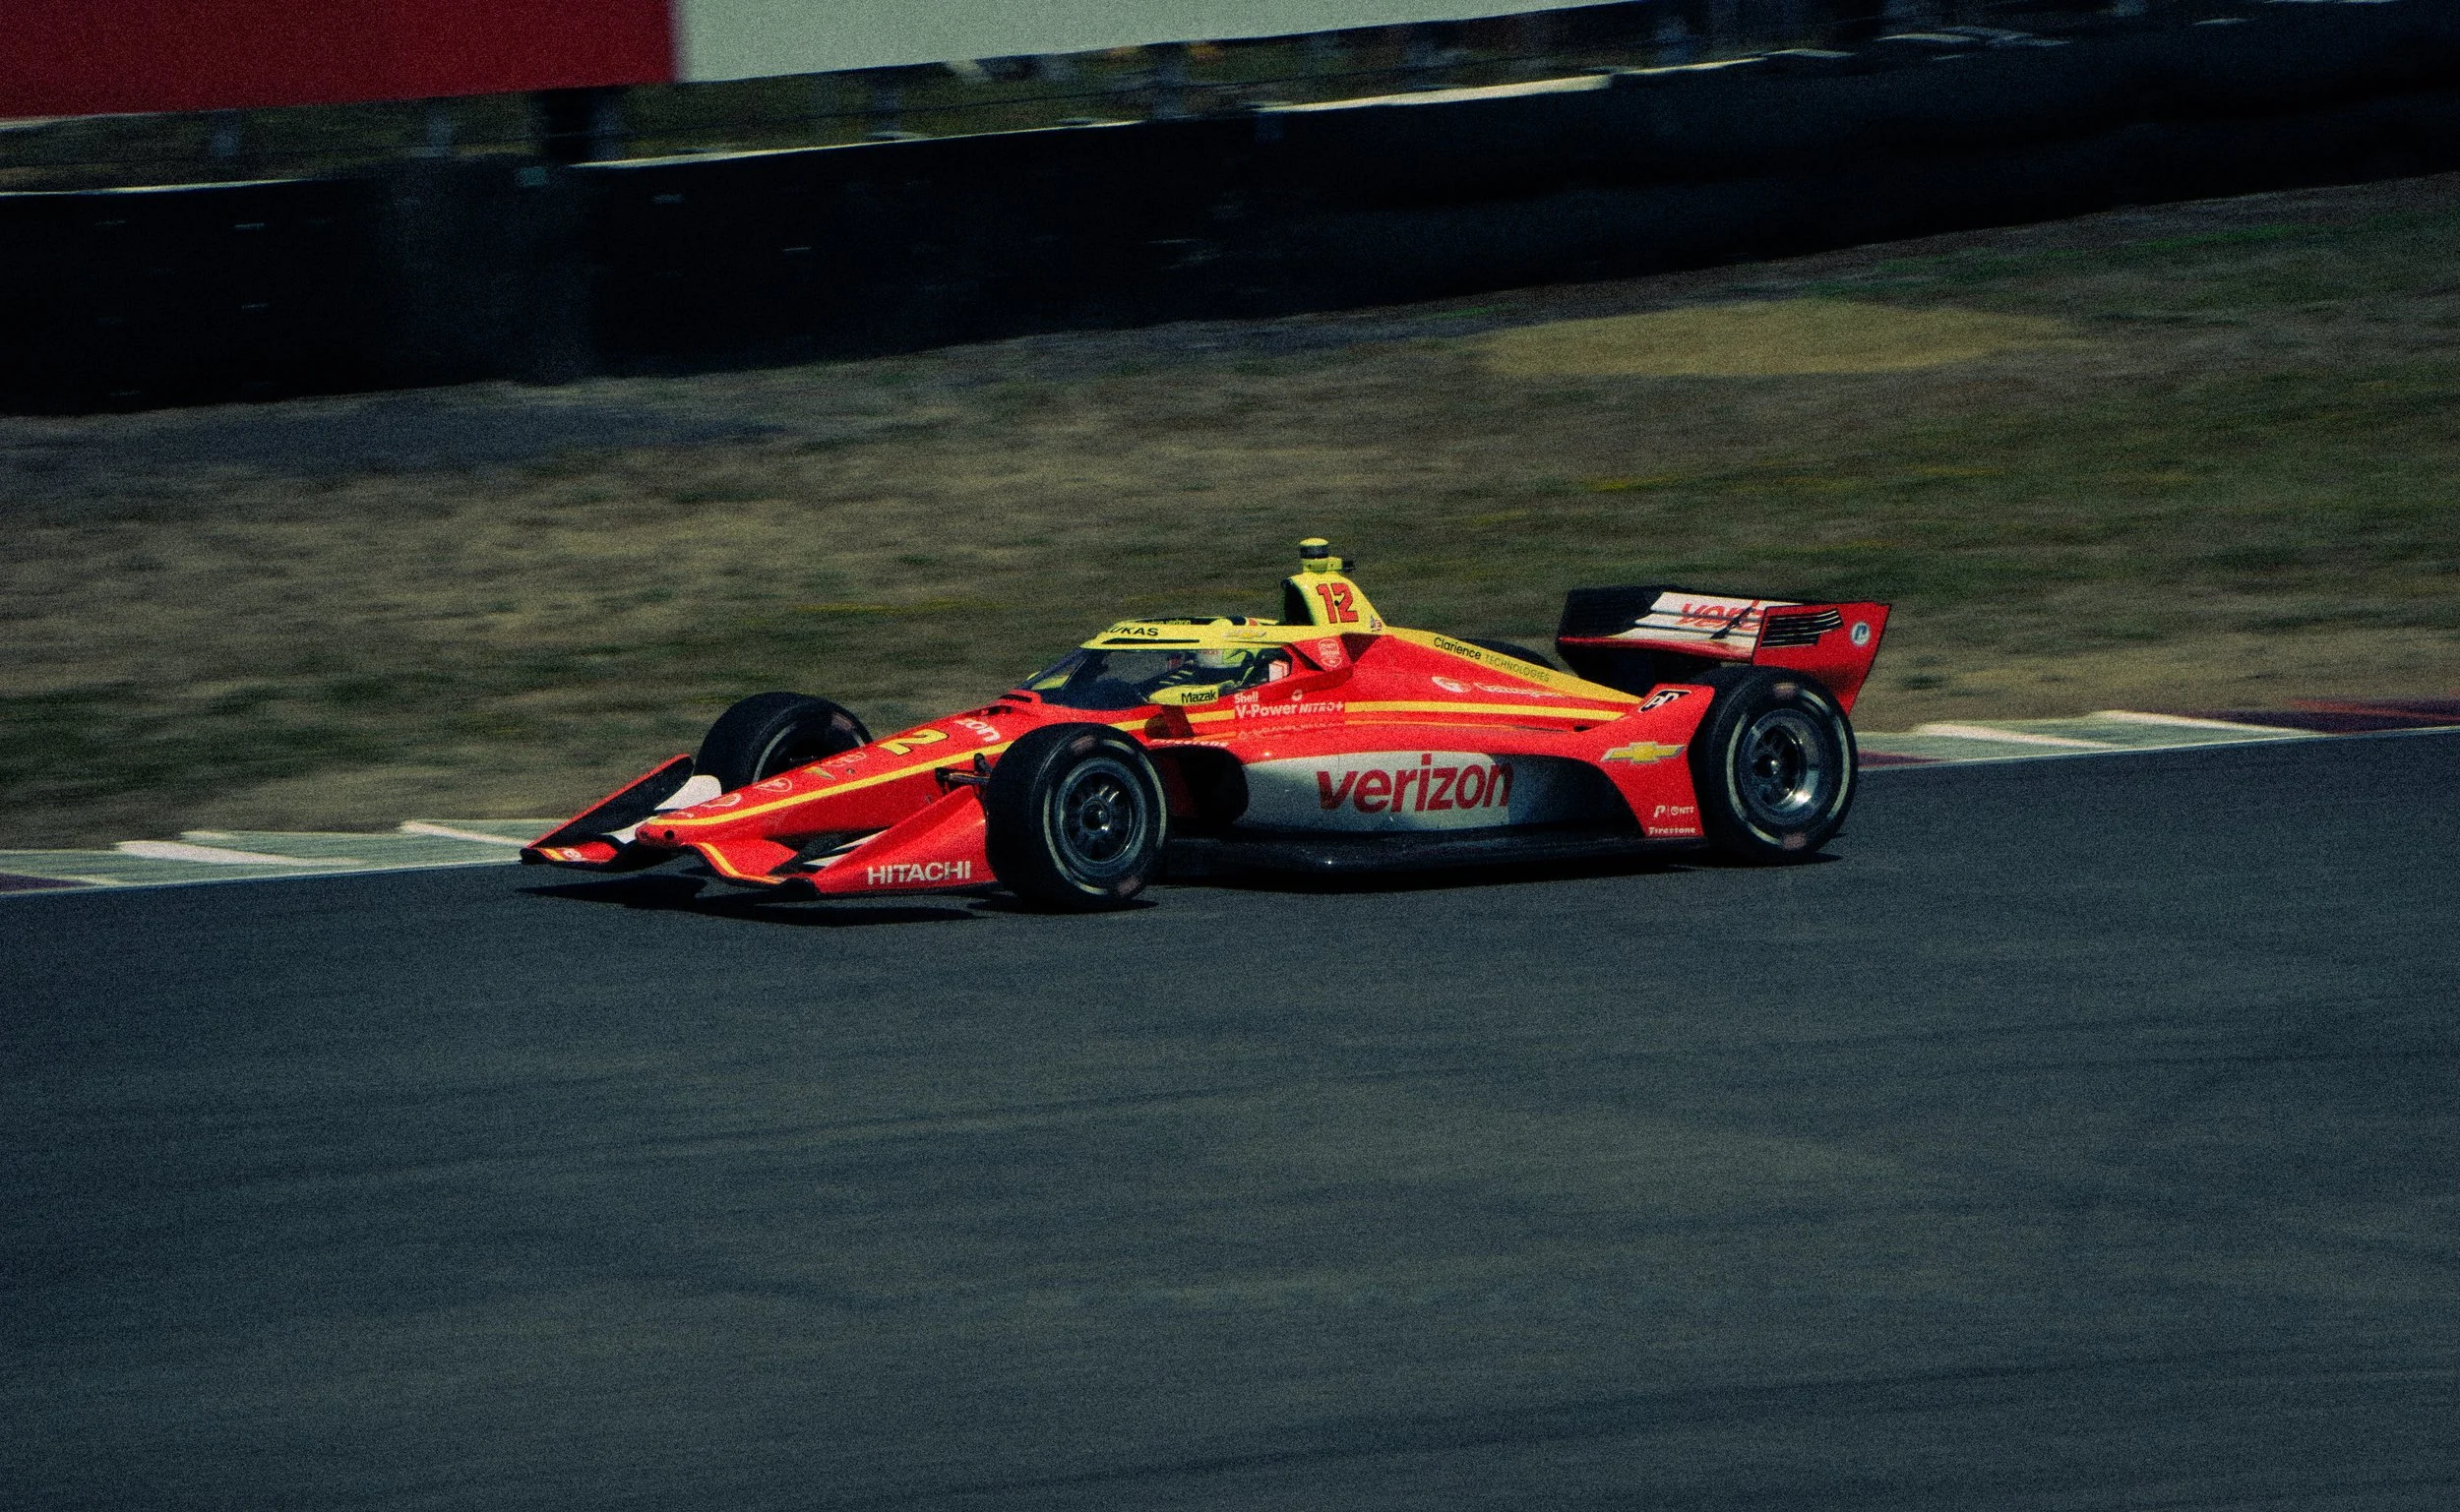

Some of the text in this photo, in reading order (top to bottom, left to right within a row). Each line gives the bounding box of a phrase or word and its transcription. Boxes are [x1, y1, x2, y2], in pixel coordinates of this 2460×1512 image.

[1316, 582, 1359, 624] 12
[1104, 627, 1159, 636] UKAS
[1433, 636, 1551, 683] Clarience TECHNOLOGIES
[1181, 690, 1216, 704] Mazak
[1234, 691, 1259, 704] Shell
[1235, 700, 1344, 719] V-Power NITRO+
[1316, 753, 1513, 814] verizon
[1647, 826, 1696, 836] Firestone
[867, 860, 972, 885] HITACHI
